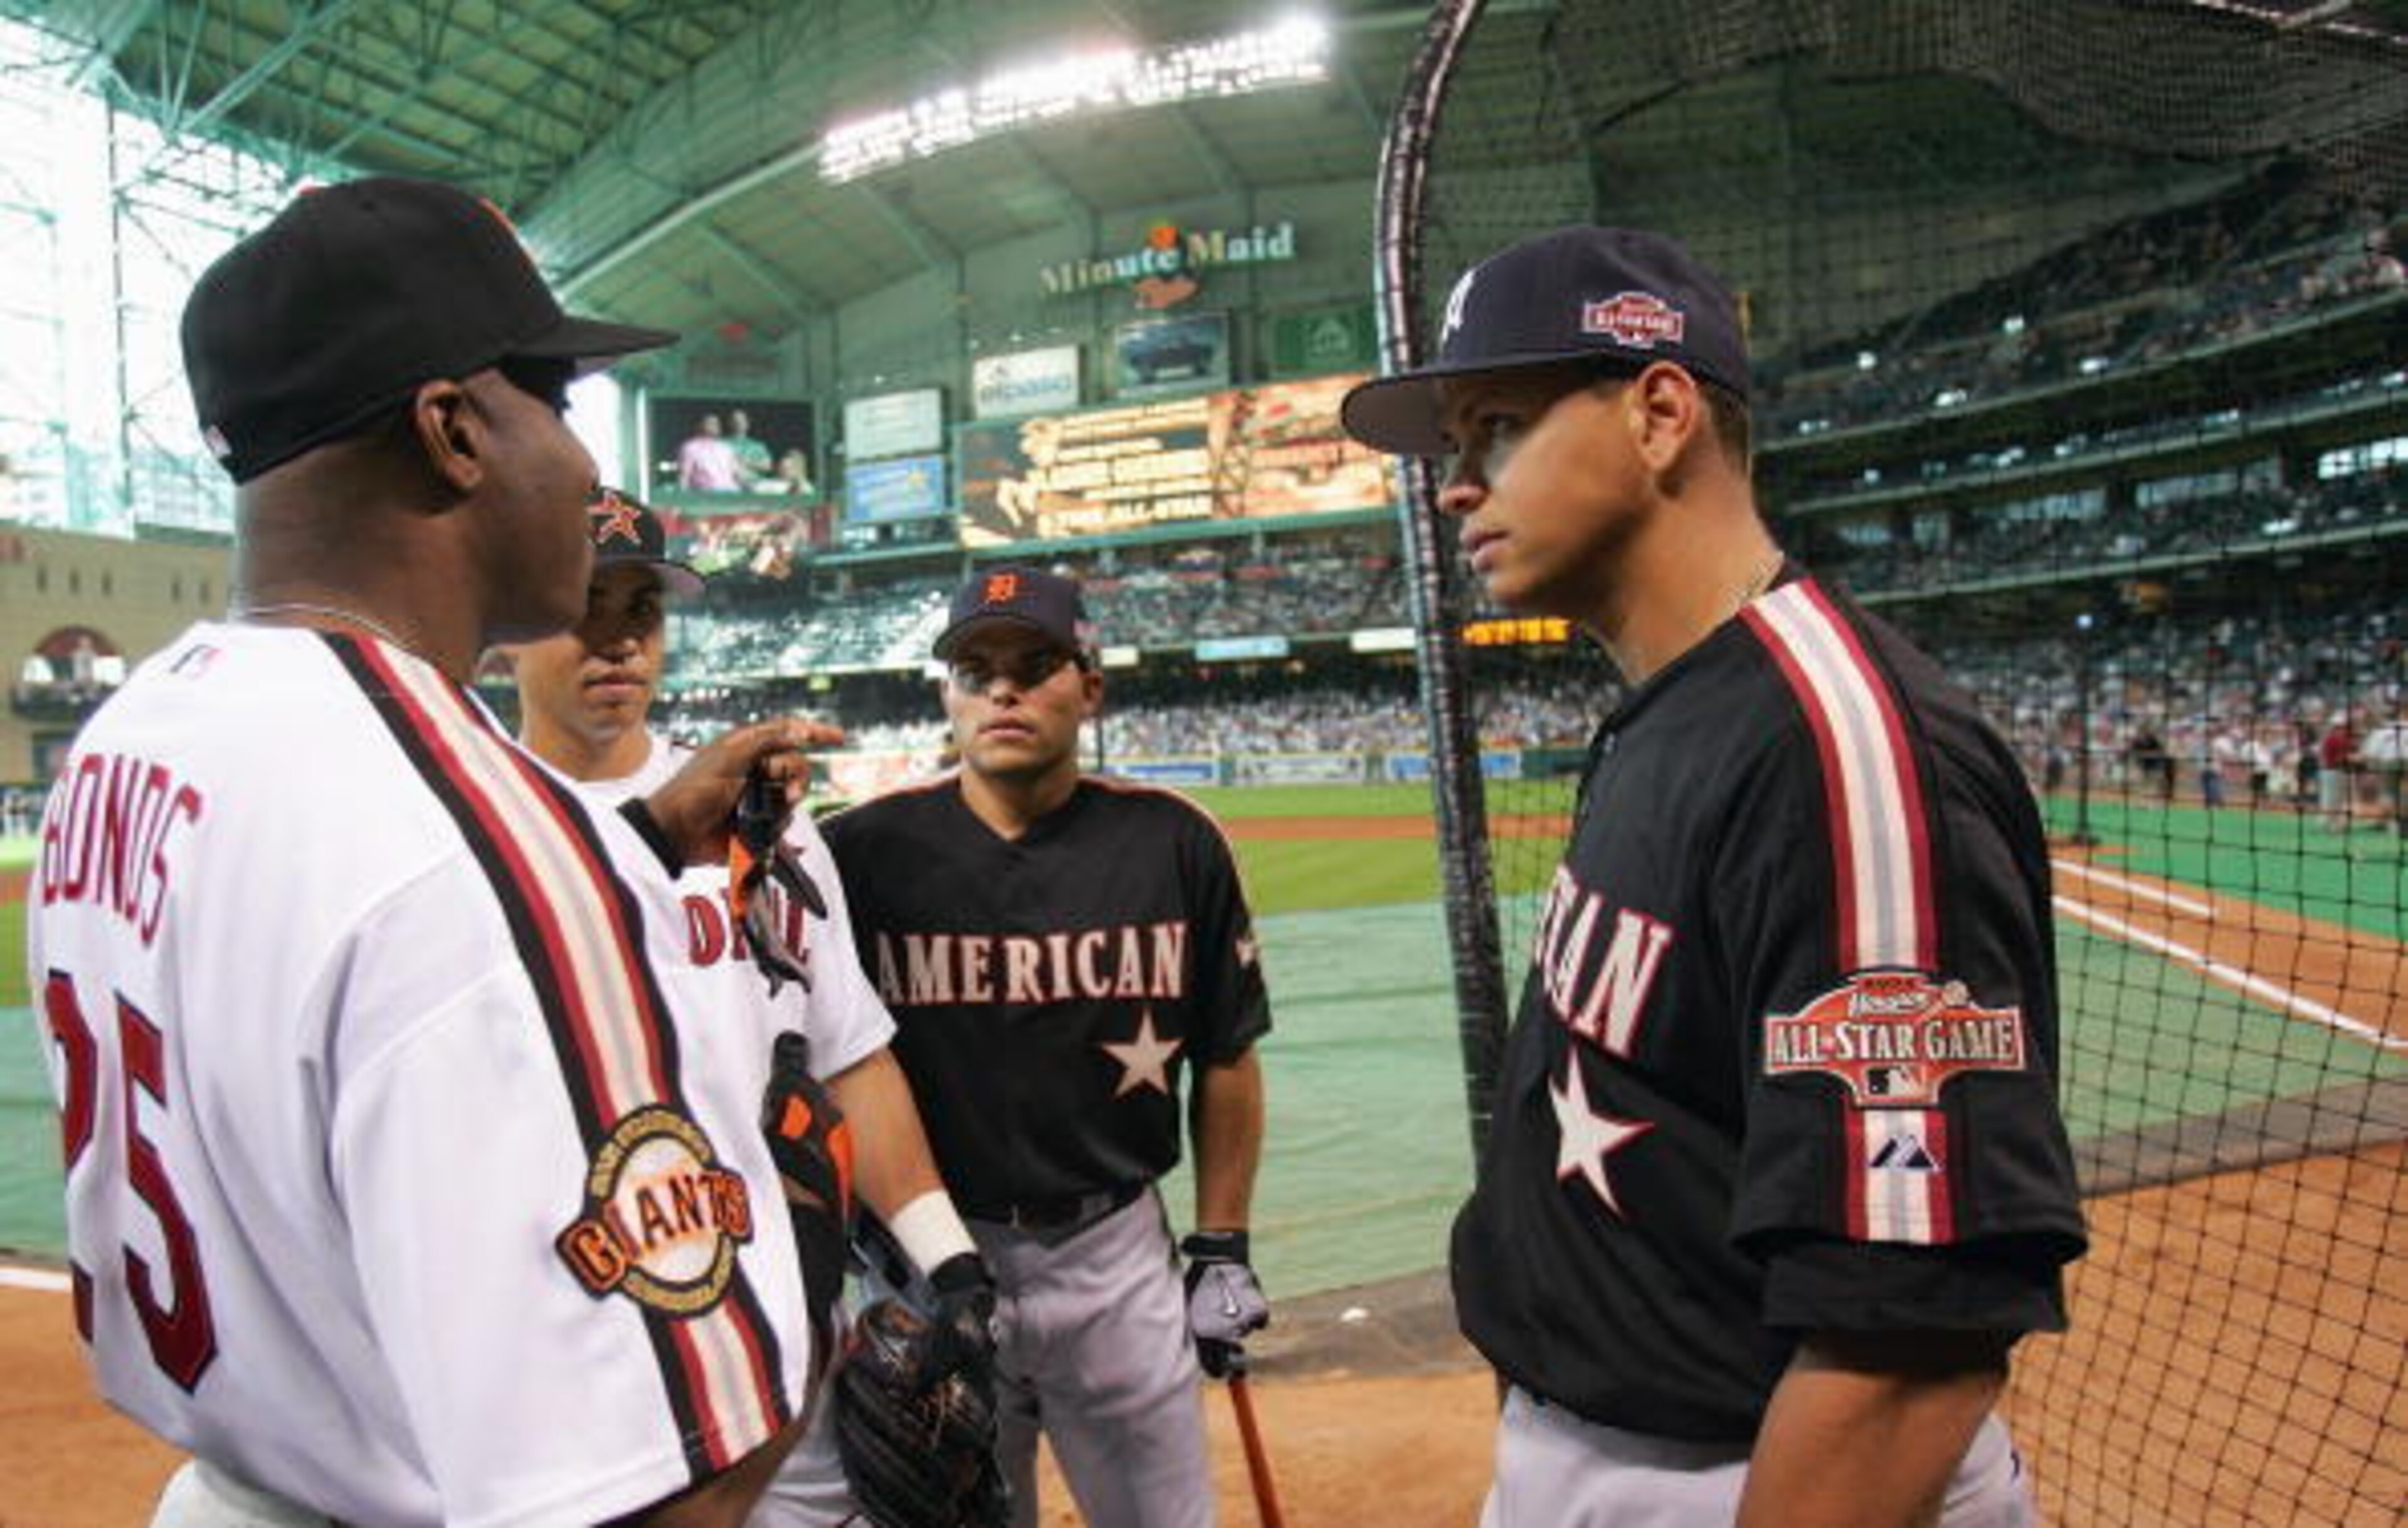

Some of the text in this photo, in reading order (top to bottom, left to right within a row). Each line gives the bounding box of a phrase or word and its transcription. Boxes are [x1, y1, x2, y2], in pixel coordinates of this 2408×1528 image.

[1040, 222, 1295, 294] Minute Maid
[42, 754, 202, 947] BONDS
[878, 923, 1188, 1004] AMERICAN
[1774, 1019, 2014, 1063] ALL-STAR GAME
[557, 1170, 748, 1289] GIANTS
